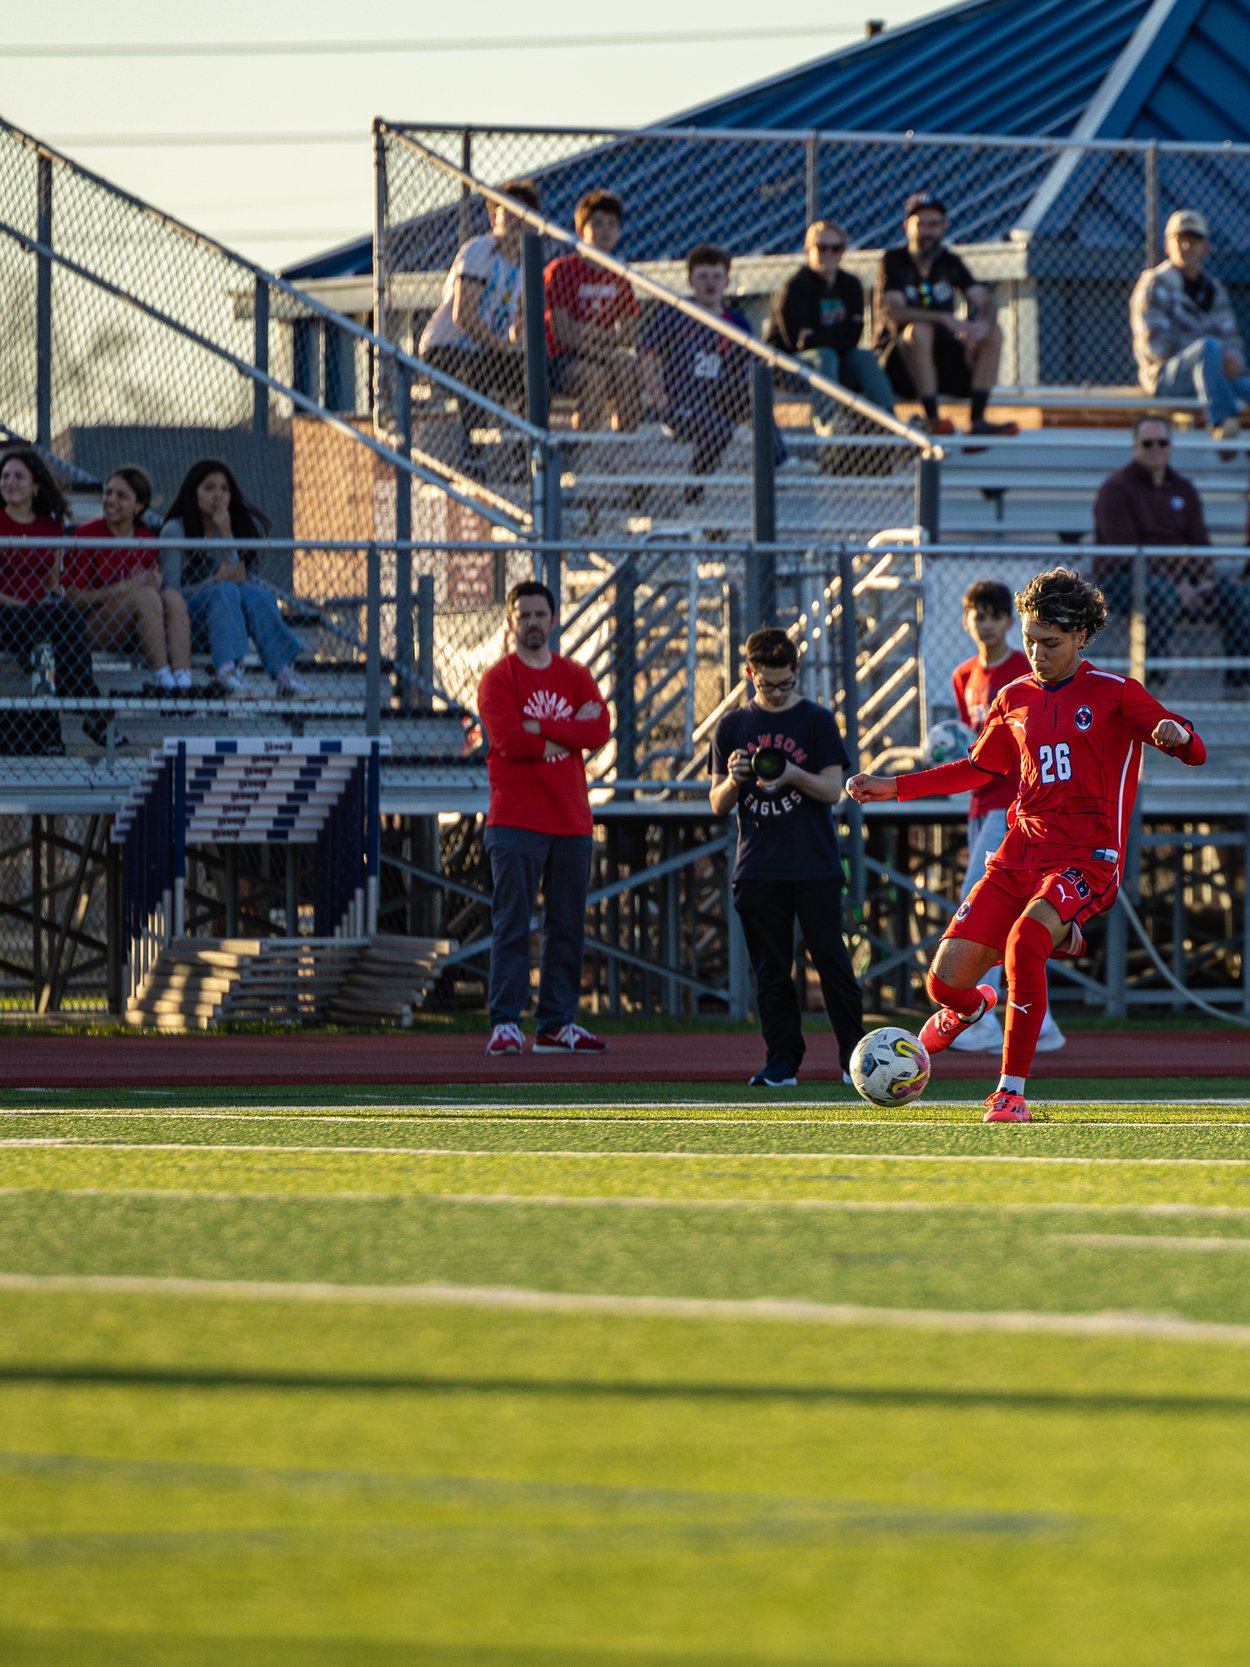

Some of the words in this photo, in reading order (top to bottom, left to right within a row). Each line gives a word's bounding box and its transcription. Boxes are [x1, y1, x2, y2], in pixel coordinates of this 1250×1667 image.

[746, 733, 808, 764] AWSON
[1038, 741, 1073, 785] 26
[744, 788, 802, 816] EAGLES
[1060, 866, 1091, 900] 26
